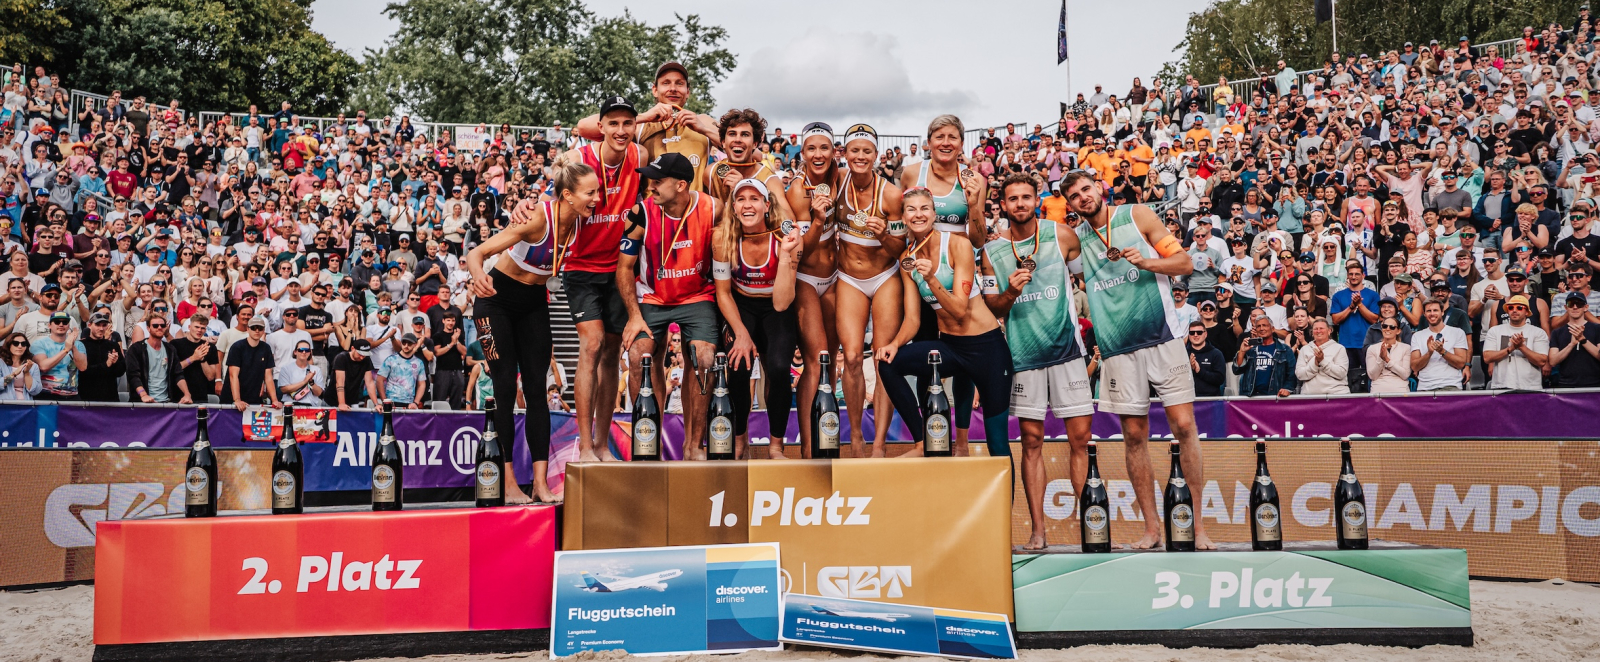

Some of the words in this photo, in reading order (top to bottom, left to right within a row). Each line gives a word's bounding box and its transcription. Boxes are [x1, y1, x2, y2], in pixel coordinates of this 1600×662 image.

[586, 214, 620, 225] Allianz
[1094, 274, 1126, 292] Allianz
[332, 432, 442, 467] Allnz
[709, 490, 738, 527] 1.
[751, 487, 873, 526] Platz
[238, 557, 282, 594] 2.
[297, 552, 423, 593] Platz
[817, 566, 912, 598] GBT
[716, 596, 744, 604] airlines
[1152, 571, 1193, 608] 3.
[1208, 568, 1334, 608] Platz
[568, 604, 676, 623] Fluggutschein
[796, 618, 906, 634] Fluggutschein
